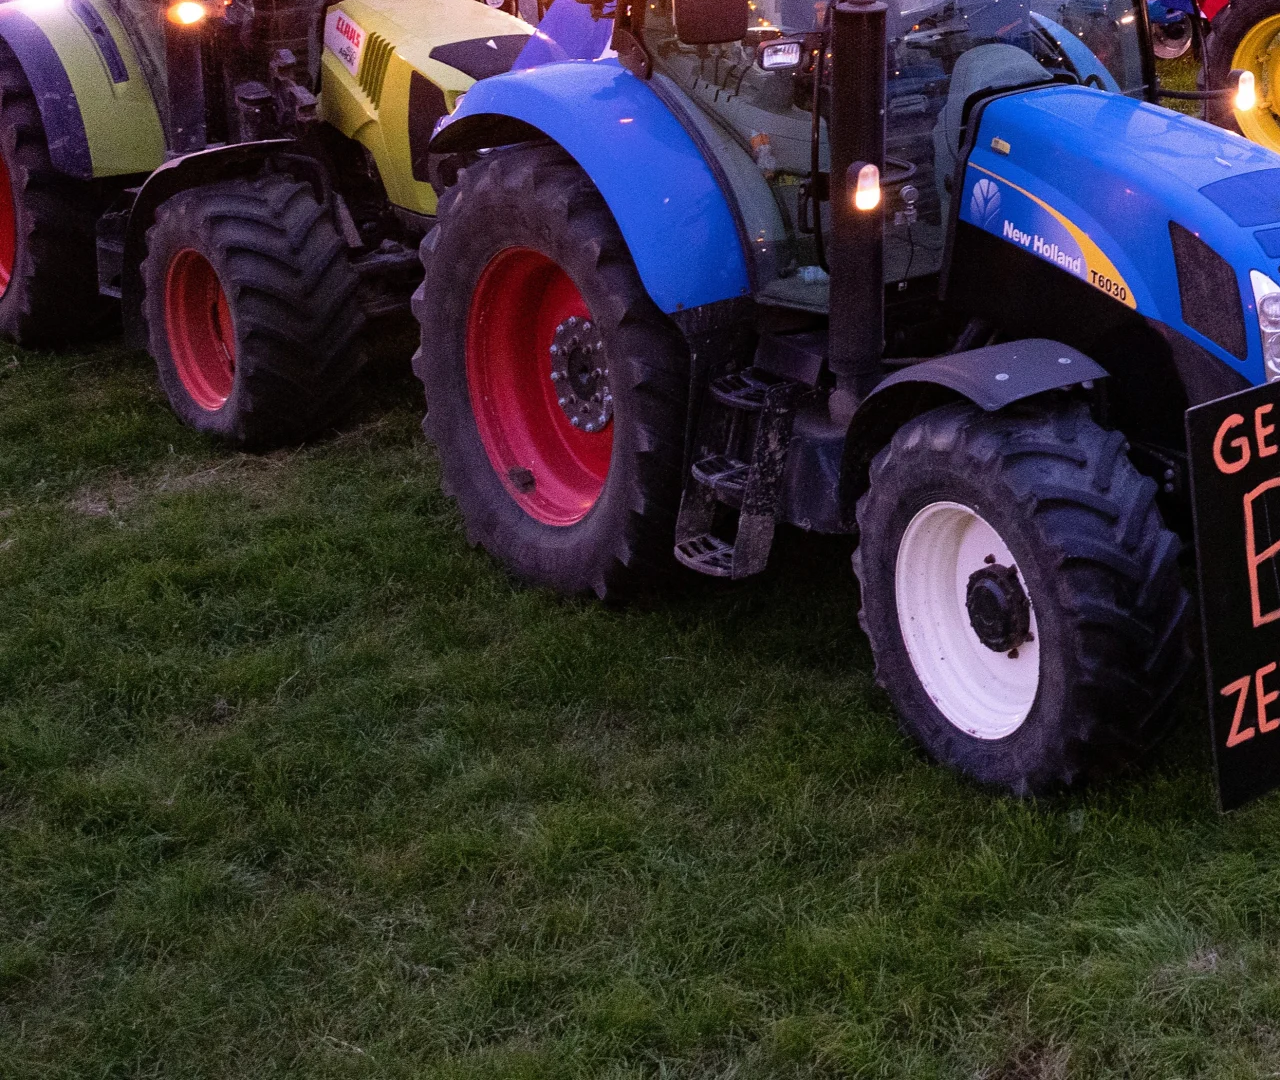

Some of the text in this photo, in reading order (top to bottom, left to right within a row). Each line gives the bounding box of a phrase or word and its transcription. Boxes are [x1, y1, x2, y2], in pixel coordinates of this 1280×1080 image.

[336, 15, 361, 48] CLAAS
[1003, 220, 1127, 302] New Holland T6030
